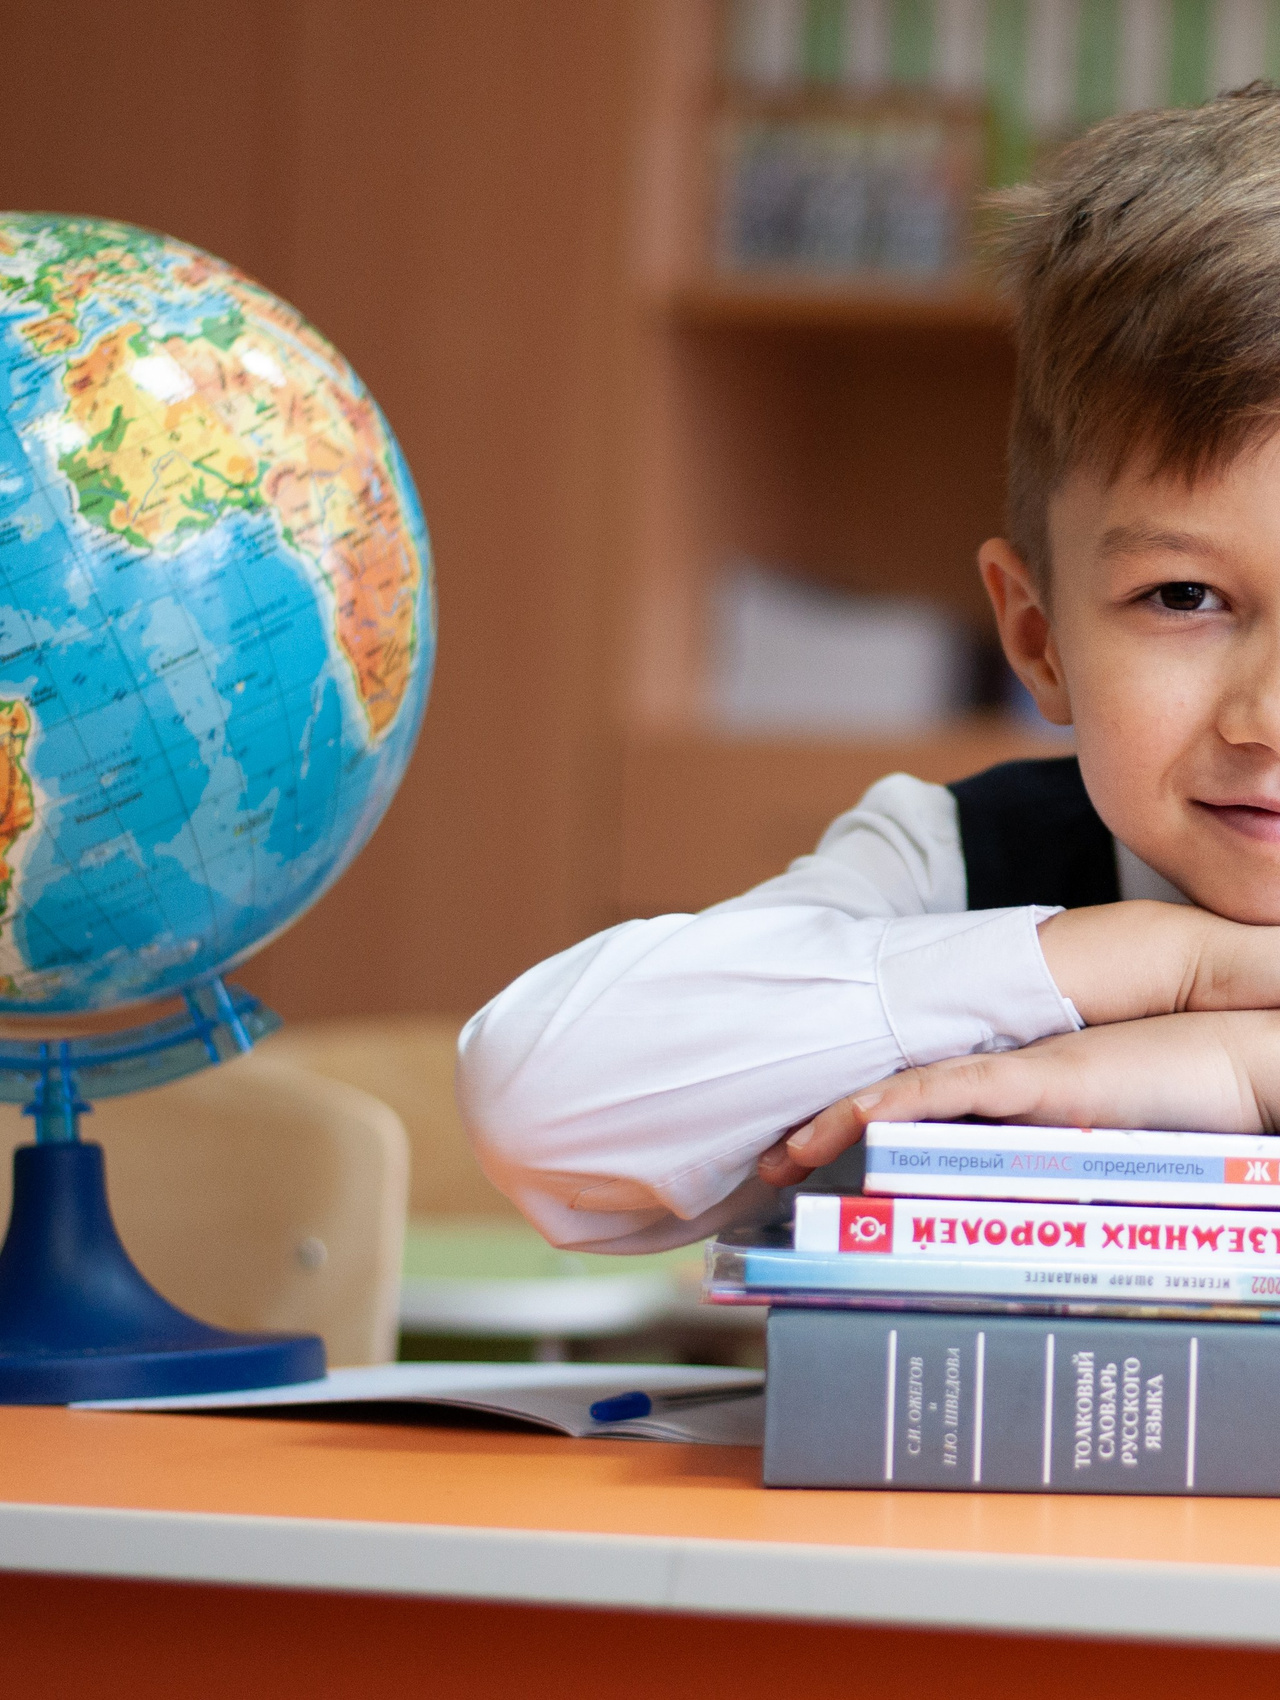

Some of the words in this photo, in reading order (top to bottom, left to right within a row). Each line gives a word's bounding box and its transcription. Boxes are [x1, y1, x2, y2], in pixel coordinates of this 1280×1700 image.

[888, 1150, 931, 1168] Твой
[938, 1153, 1004, 1171] первый
[1010, 1154, 1073, 1172] АТЛАС
[1083, 1158, 1205, 1177] определитель
[912, 1216, 1087, 1250] КОРОЛЕЙ
[909, 1356, 924, 1420] ОЖЕГОВ
[944, 1346, 961, 1425] ШВЕДОВА
[1071, 1350, 1095, 1469] ТОЛКОВЫЙ
[1098, 1362, 1118, 1460] СЛОВАРЬ
[1121, 1357, 1142, 1466] РУССКОГО
[1145, 1374, 1165, 1450] ЯЗЫКА
